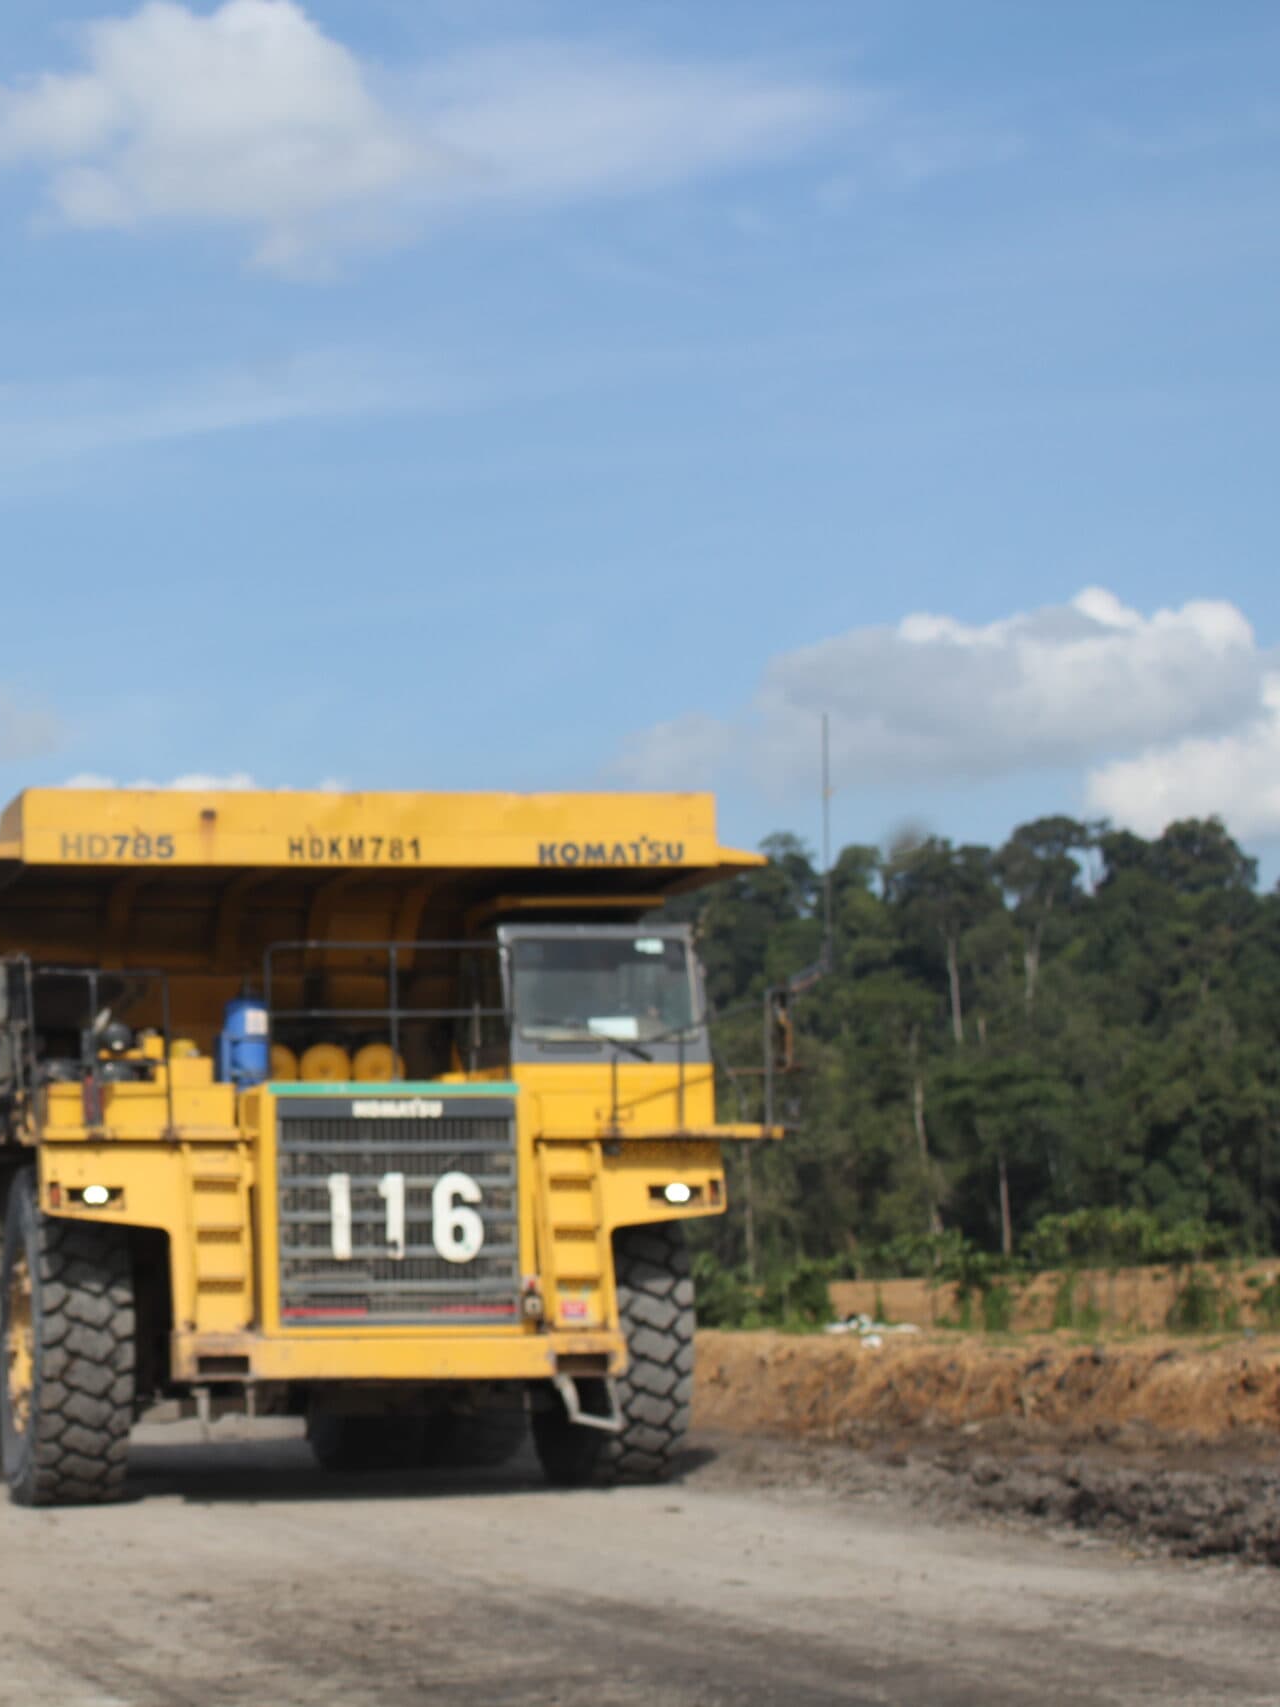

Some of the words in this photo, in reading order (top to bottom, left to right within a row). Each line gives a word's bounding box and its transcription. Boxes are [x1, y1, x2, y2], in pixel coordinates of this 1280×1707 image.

[60, 833, 175, 859] HD785
[287, 834, 421, 861] HDKM781
[537, 836, 685, 866] KOMATSU
[327, 1171, 485, 1263] 116
